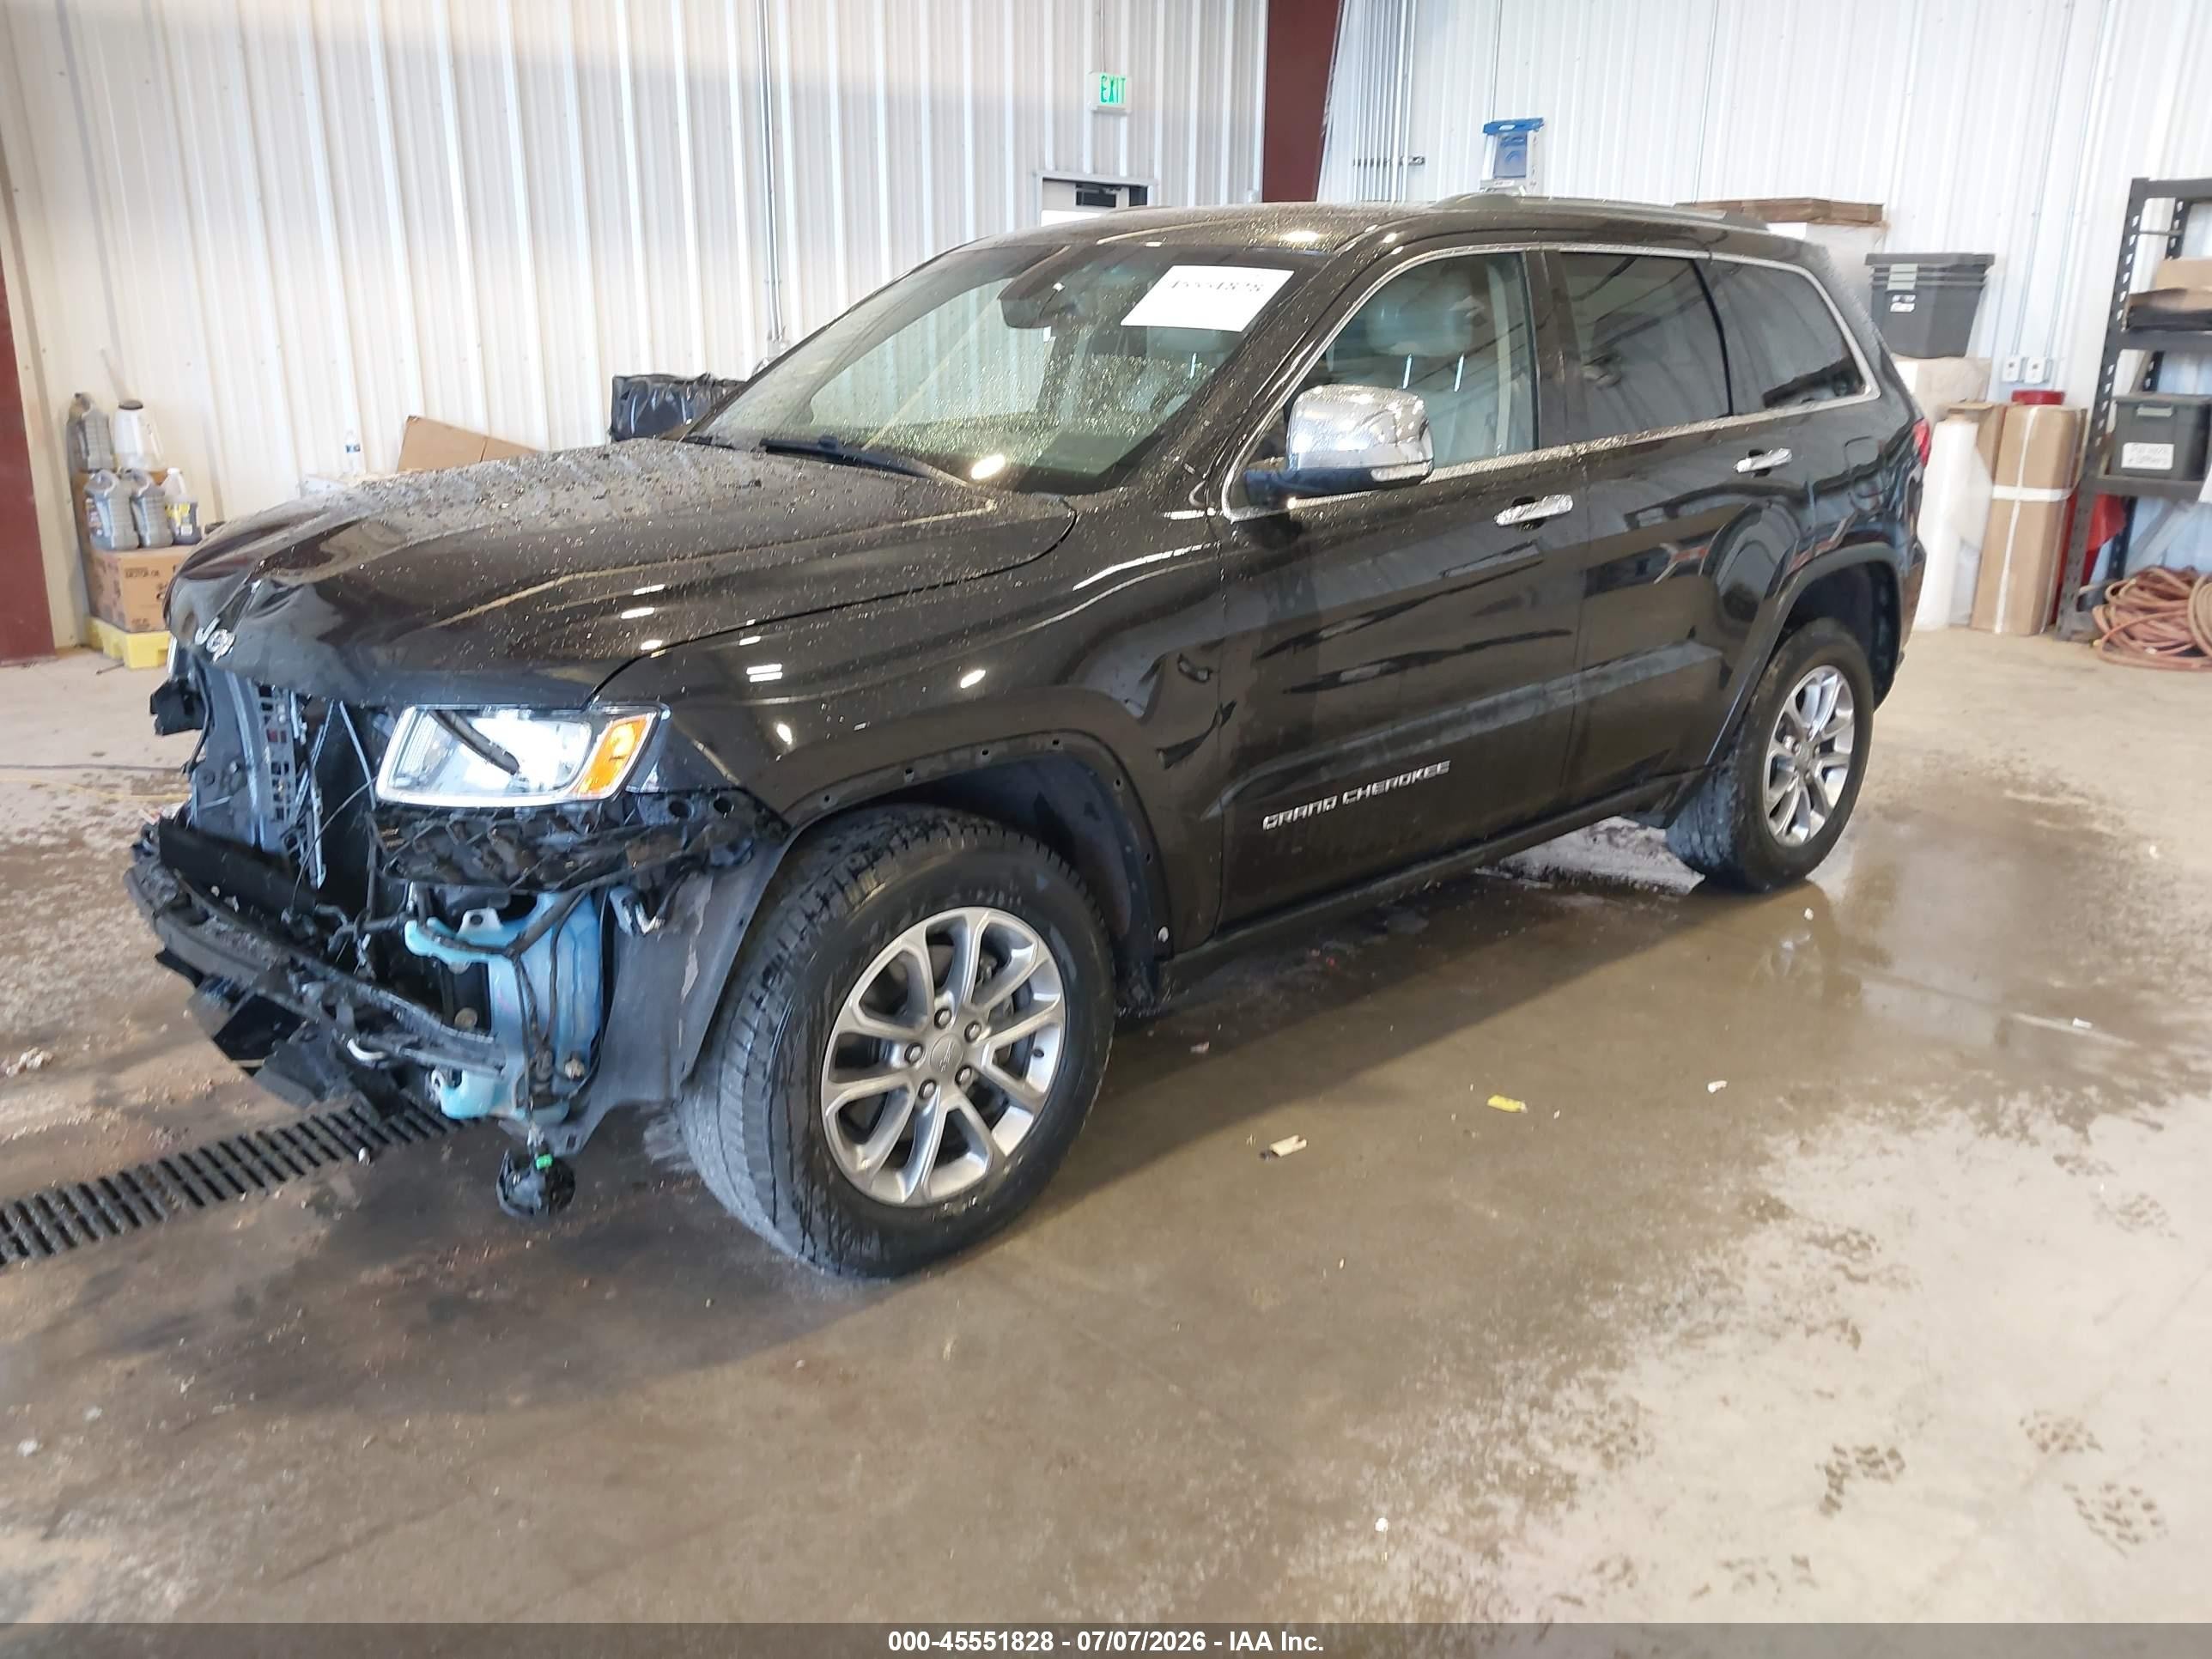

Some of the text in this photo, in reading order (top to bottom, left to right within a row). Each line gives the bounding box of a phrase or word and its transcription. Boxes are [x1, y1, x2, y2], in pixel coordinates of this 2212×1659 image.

[1100, 75, 1126, 103] EXIT
[1262, 760, 1451, 831] GRAND CHEROKEE
